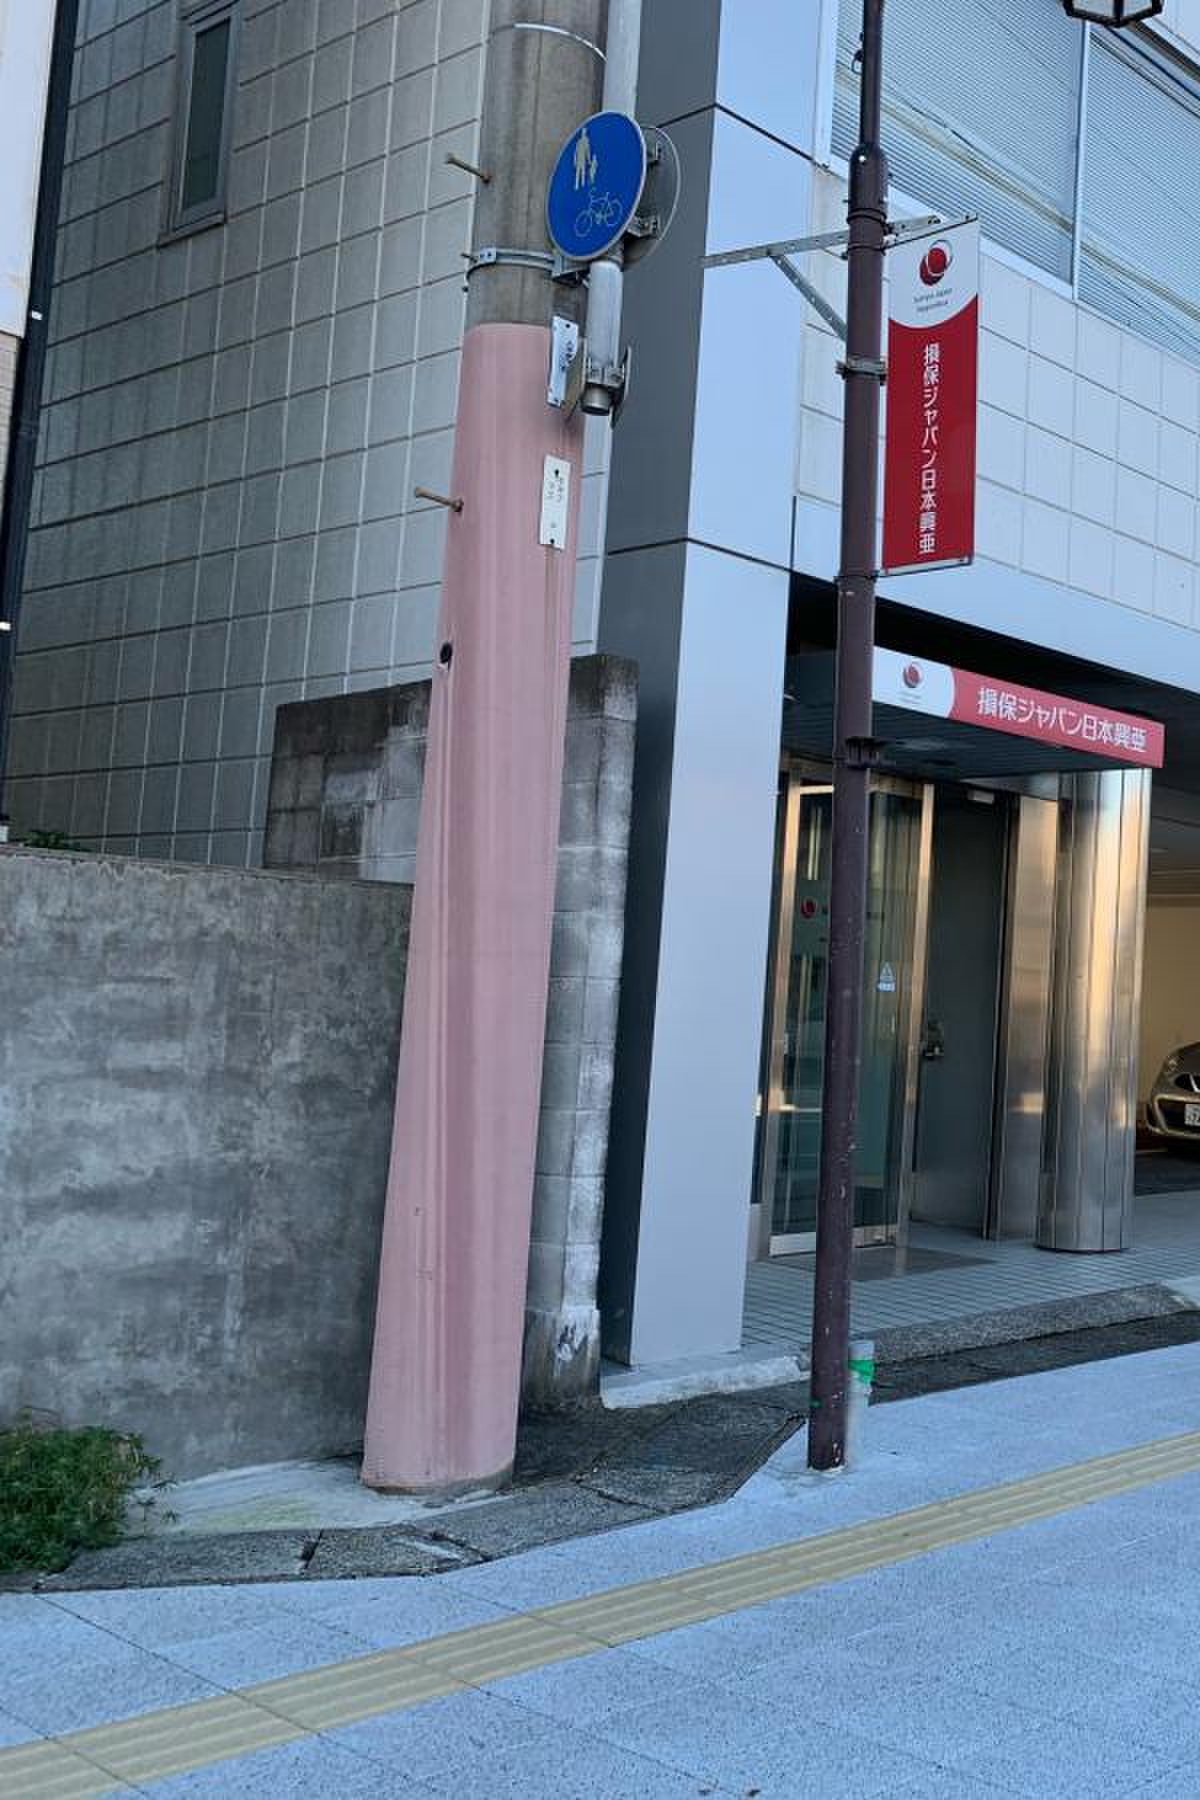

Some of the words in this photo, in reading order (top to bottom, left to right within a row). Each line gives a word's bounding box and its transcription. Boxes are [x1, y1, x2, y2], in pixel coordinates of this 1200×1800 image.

[919, 343, 940, 554] 損保ジャパン日本興亜
[976, 687, 1148, 752] 損保ジャパン日本興亜
